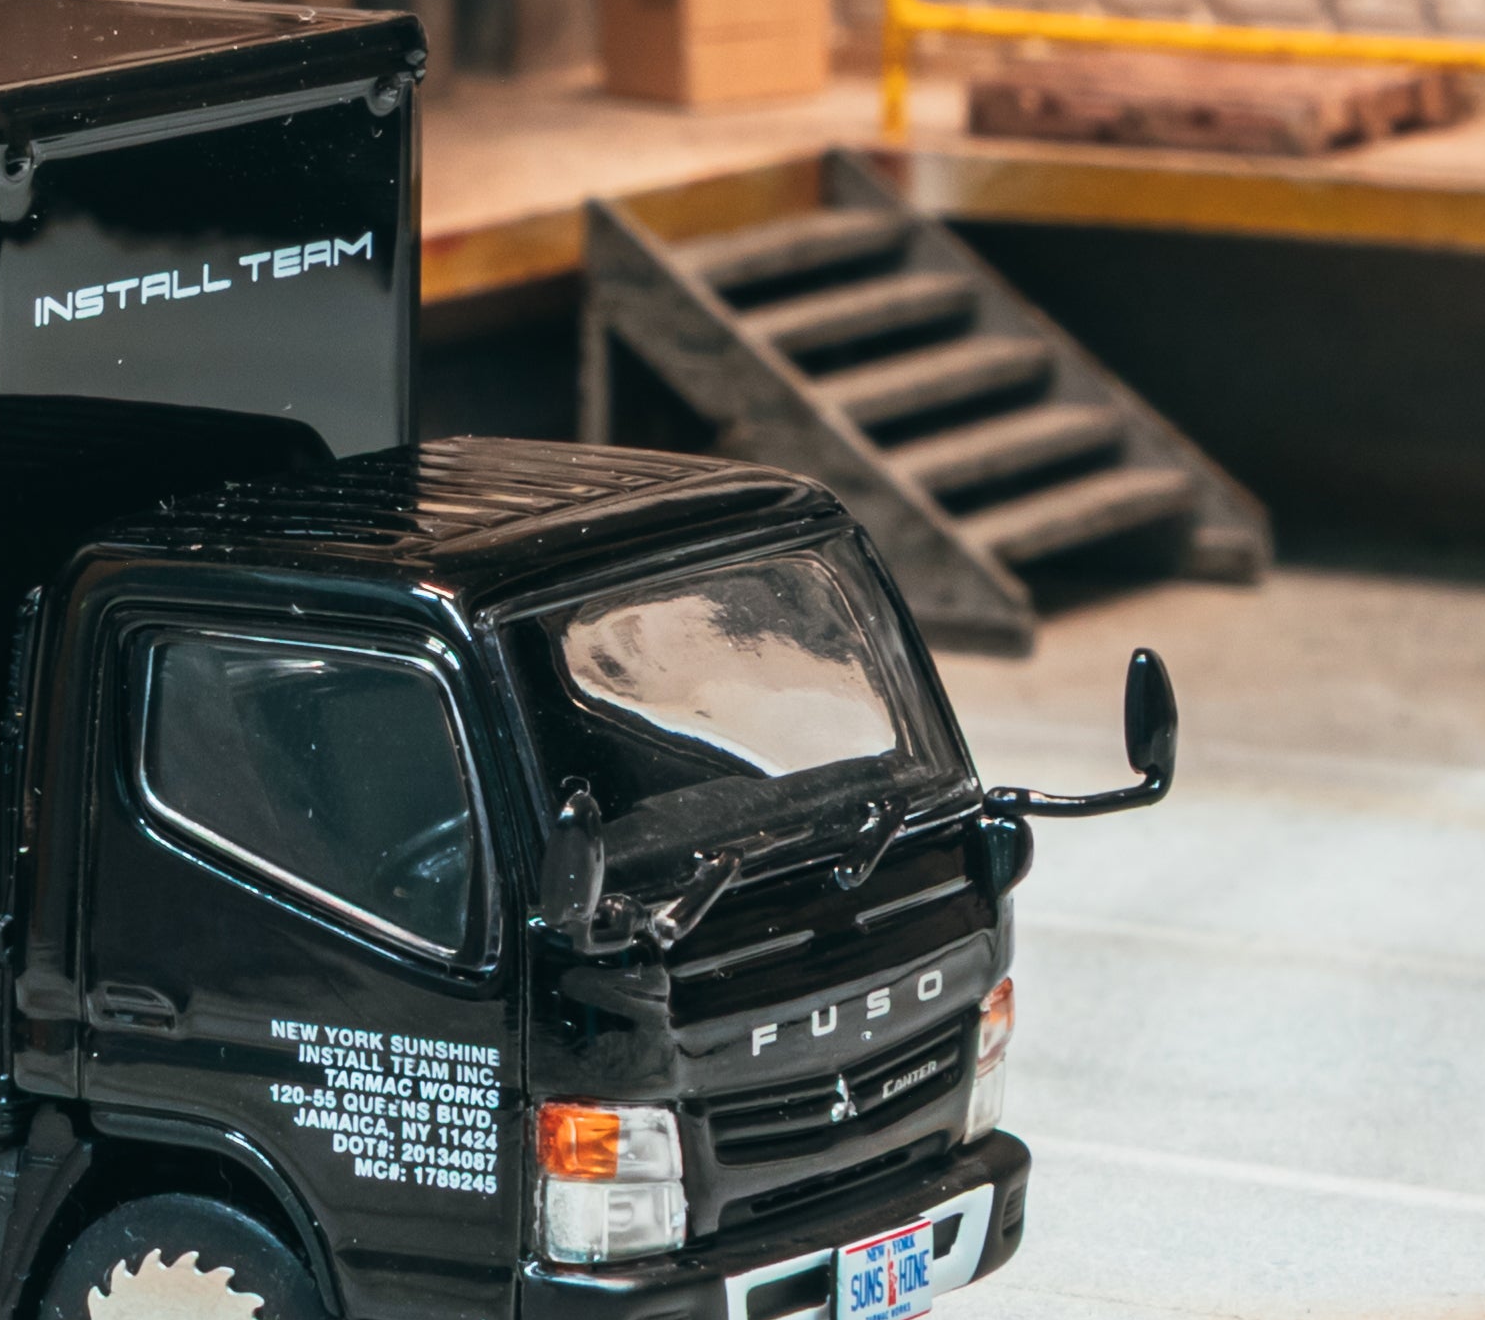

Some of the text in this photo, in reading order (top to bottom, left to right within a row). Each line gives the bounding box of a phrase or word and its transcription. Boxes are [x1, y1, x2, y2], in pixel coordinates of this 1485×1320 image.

[34, 231, 373, 328] INSTALL TEAM
[751, 969, 943, 1057] FUSO
[271, 1019, 500, 1067] NEW YORK SUNSHINE
[298, 1043, 501, 1087] INSTALL TEAM INC.
[269, 1083, 498, 1132] 120-55 QUEENS BLVD,
[324, 1068, 500, 1110] TARMAC WORKS
[293, 1107, 498, 1151] JAMAICA, NY 11424
[333, 1133, 497, 1172] DOT#: 20134087
[354, 1157, 498, 1194] MC#: 1789245
